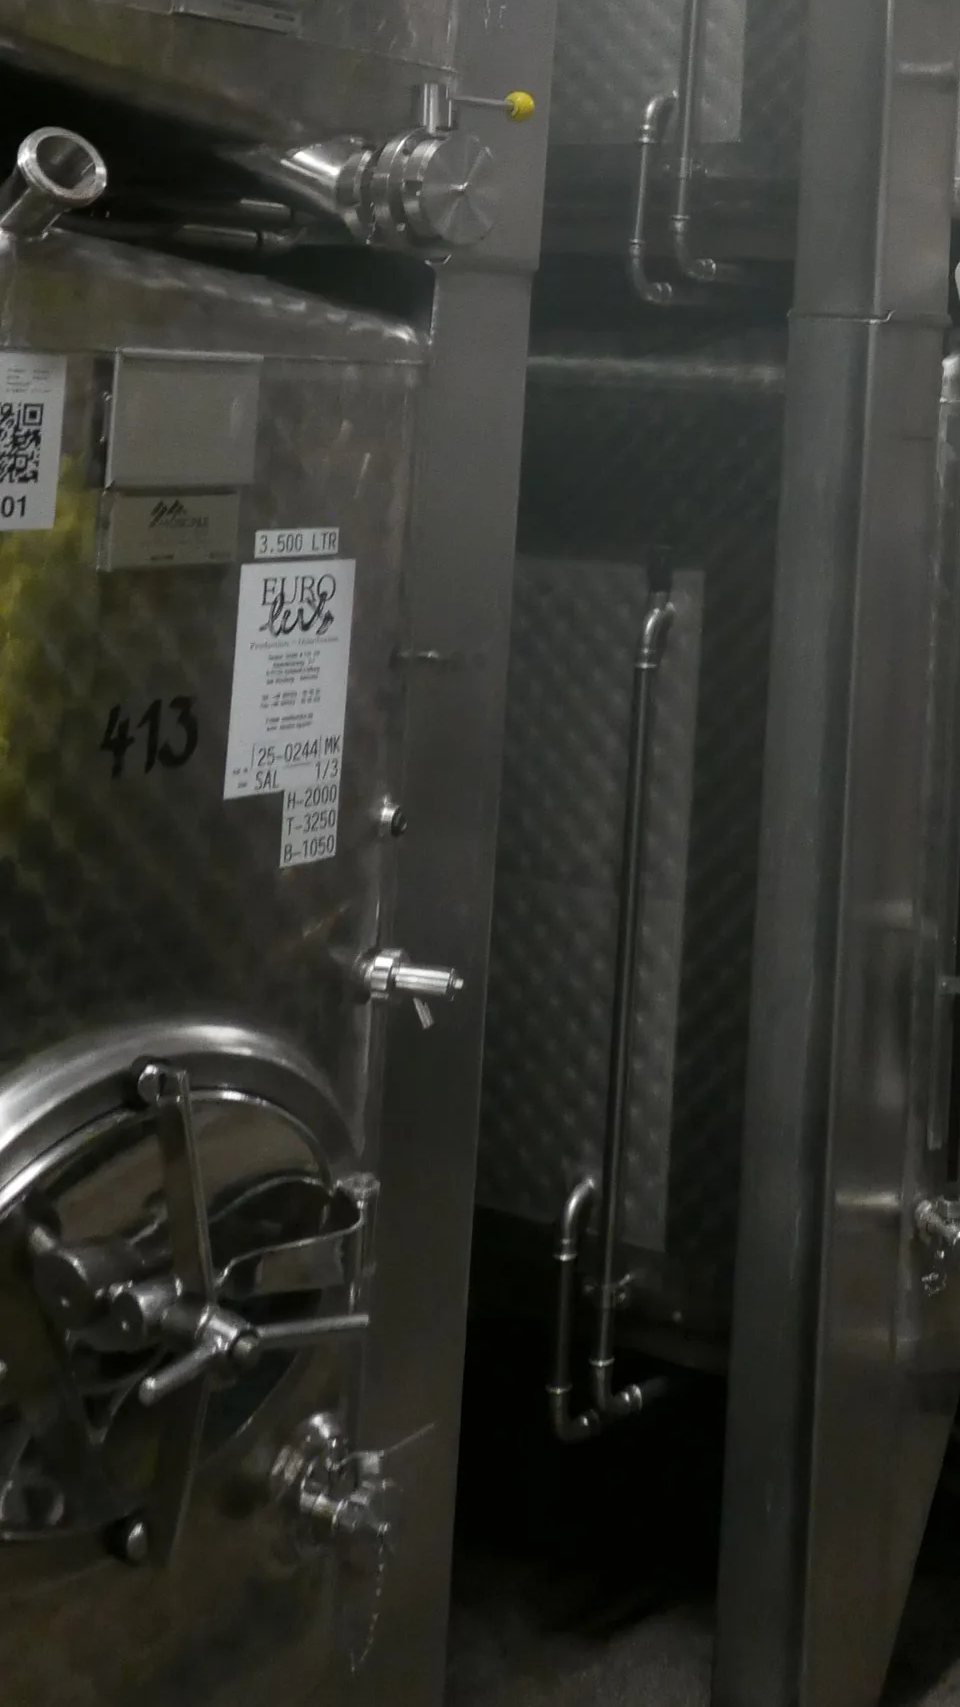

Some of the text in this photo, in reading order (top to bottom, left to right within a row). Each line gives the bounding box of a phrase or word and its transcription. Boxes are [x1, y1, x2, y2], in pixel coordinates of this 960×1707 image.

[259, 531, 337, 554] 3.500 LTR
[262, 574, 336, 606] EURO
[100, 695, 200, 780] 413
[257, 734, 341, 767] 25-0244 MK
[254, 769, 280, 790] SAL
[315, 757, 339, 781] 1/3
[286, 783, 338, 810] H-2000
[286, 809, 336, 836] T-3250
[283, 834, 335, 863] B-1050
